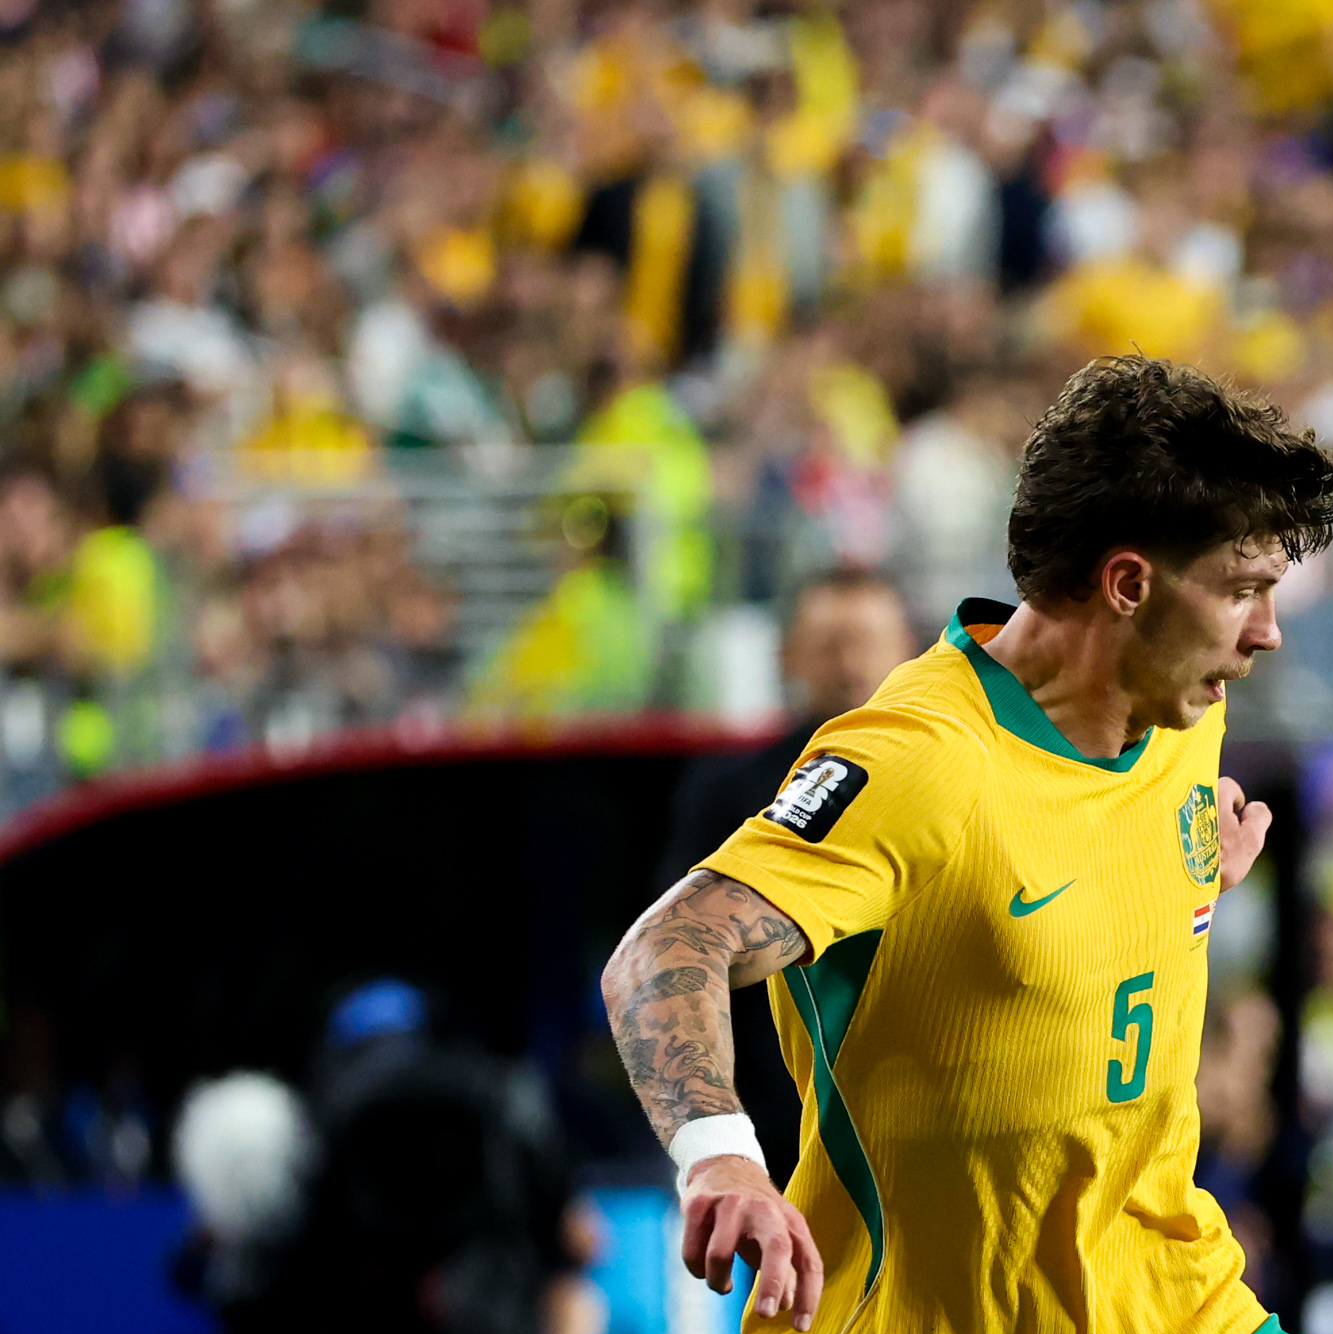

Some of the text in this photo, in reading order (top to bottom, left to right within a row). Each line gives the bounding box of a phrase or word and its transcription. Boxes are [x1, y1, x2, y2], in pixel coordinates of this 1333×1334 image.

[782, 810, 808, 829] 026
[799, 811, 813, 821] CUP
[1106, 971, 1155, 1103] 5
